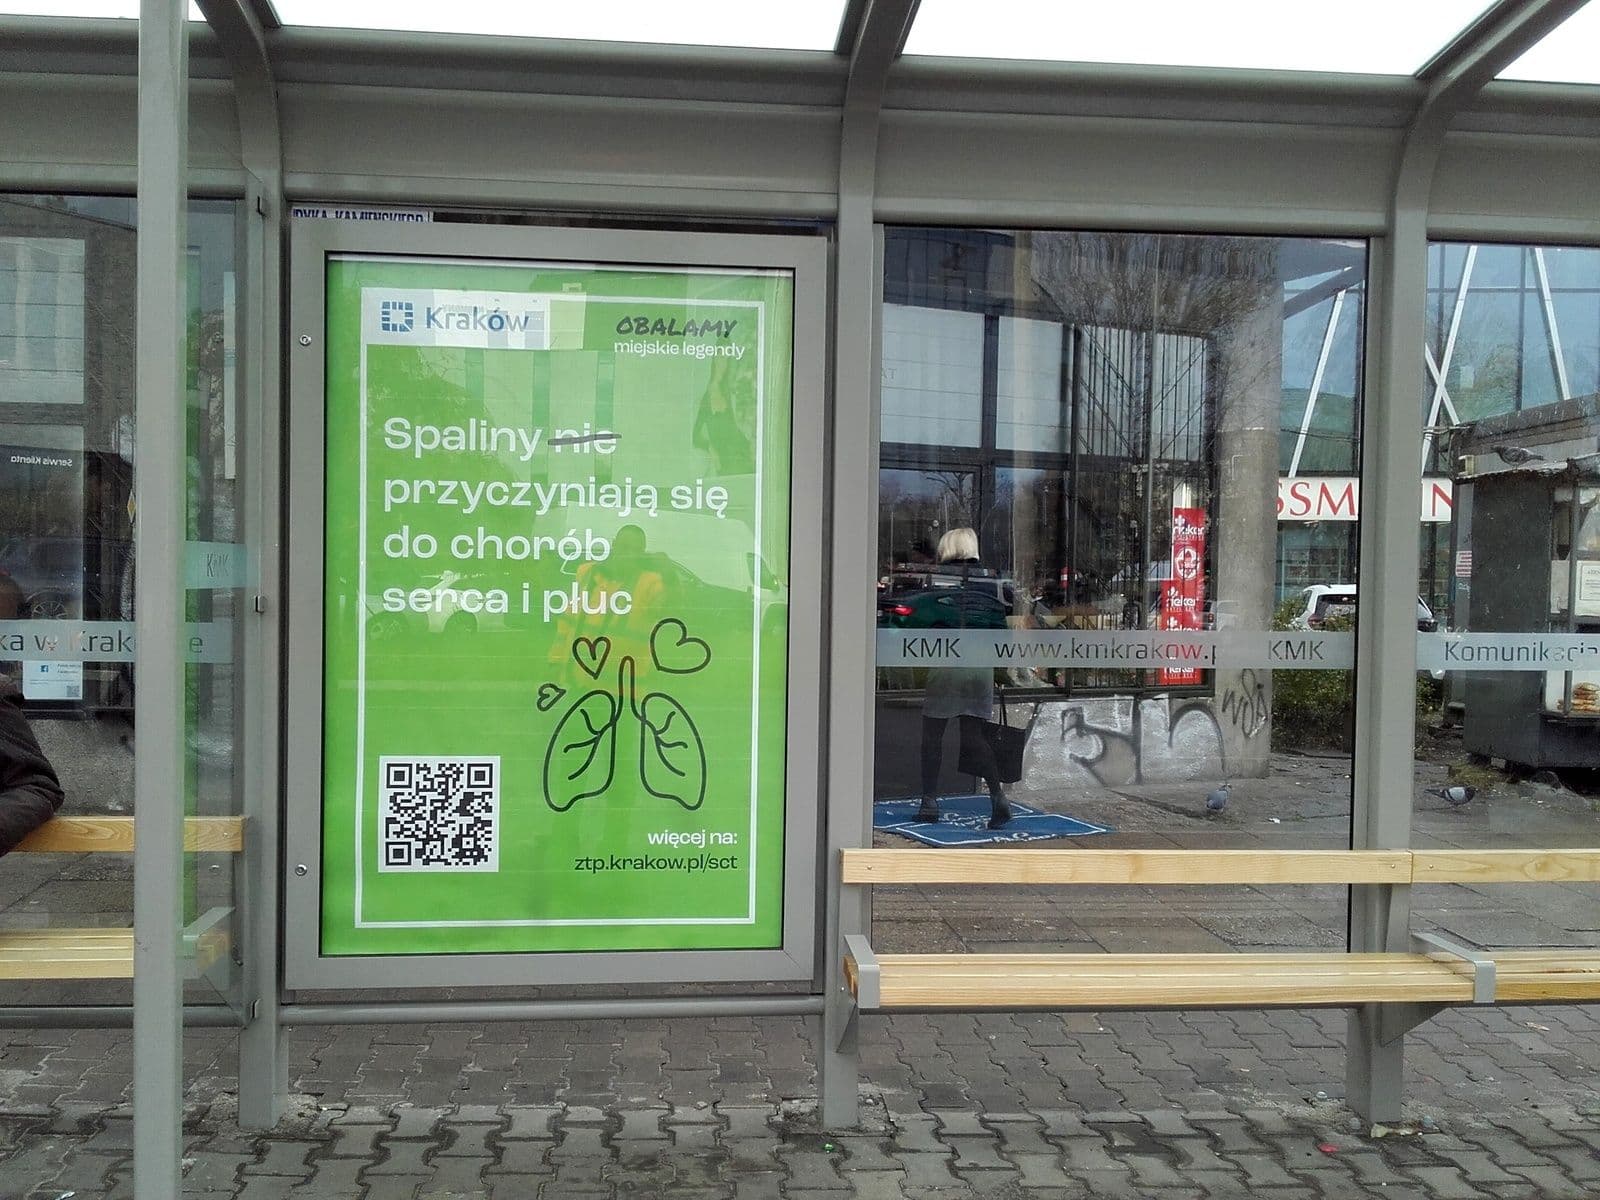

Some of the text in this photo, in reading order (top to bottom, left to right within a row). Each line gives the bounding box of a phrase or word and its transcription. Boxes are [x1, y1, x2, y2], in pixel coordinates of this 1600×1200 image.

[426, 306, 529, 332] Kraków
[616, 316, 738, 338] OBALAMY
[614, 340, 745, 360] miejskie legendy
[384, 418, 617, 461] Spaliny nie
[384, 476, 729, 519] przyczyniają się
[383, 525, 611, 562] do chorób
[383, 582, 633, 623] serca i płuc
[902, 637, 961, 658] KMK
[1268, 640, 1325, 661] KMK
[647, 829, 738, 849] więcej na:
[574, 853, 738, 874] ztp.krakow.pl/sct
